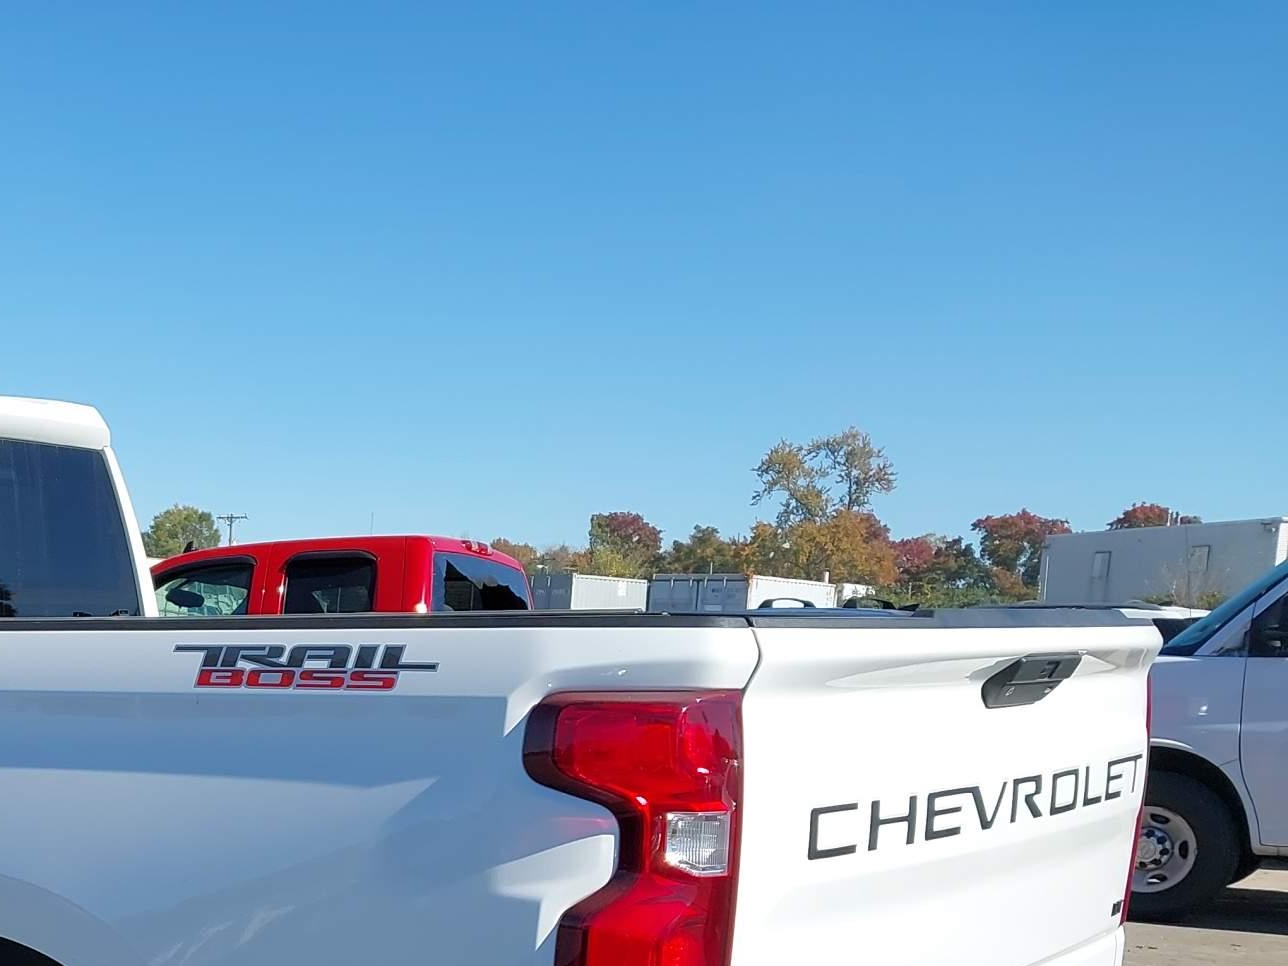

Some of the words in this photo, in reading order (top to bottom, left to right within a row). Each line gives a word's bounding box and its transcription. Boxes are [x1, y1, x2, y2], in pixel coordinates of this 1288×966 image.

[172, 644, 439, 672] TRAIL
[194, 668, 400, 690] BOSS
[808, 753, 1143, 861] CHEVROLET
